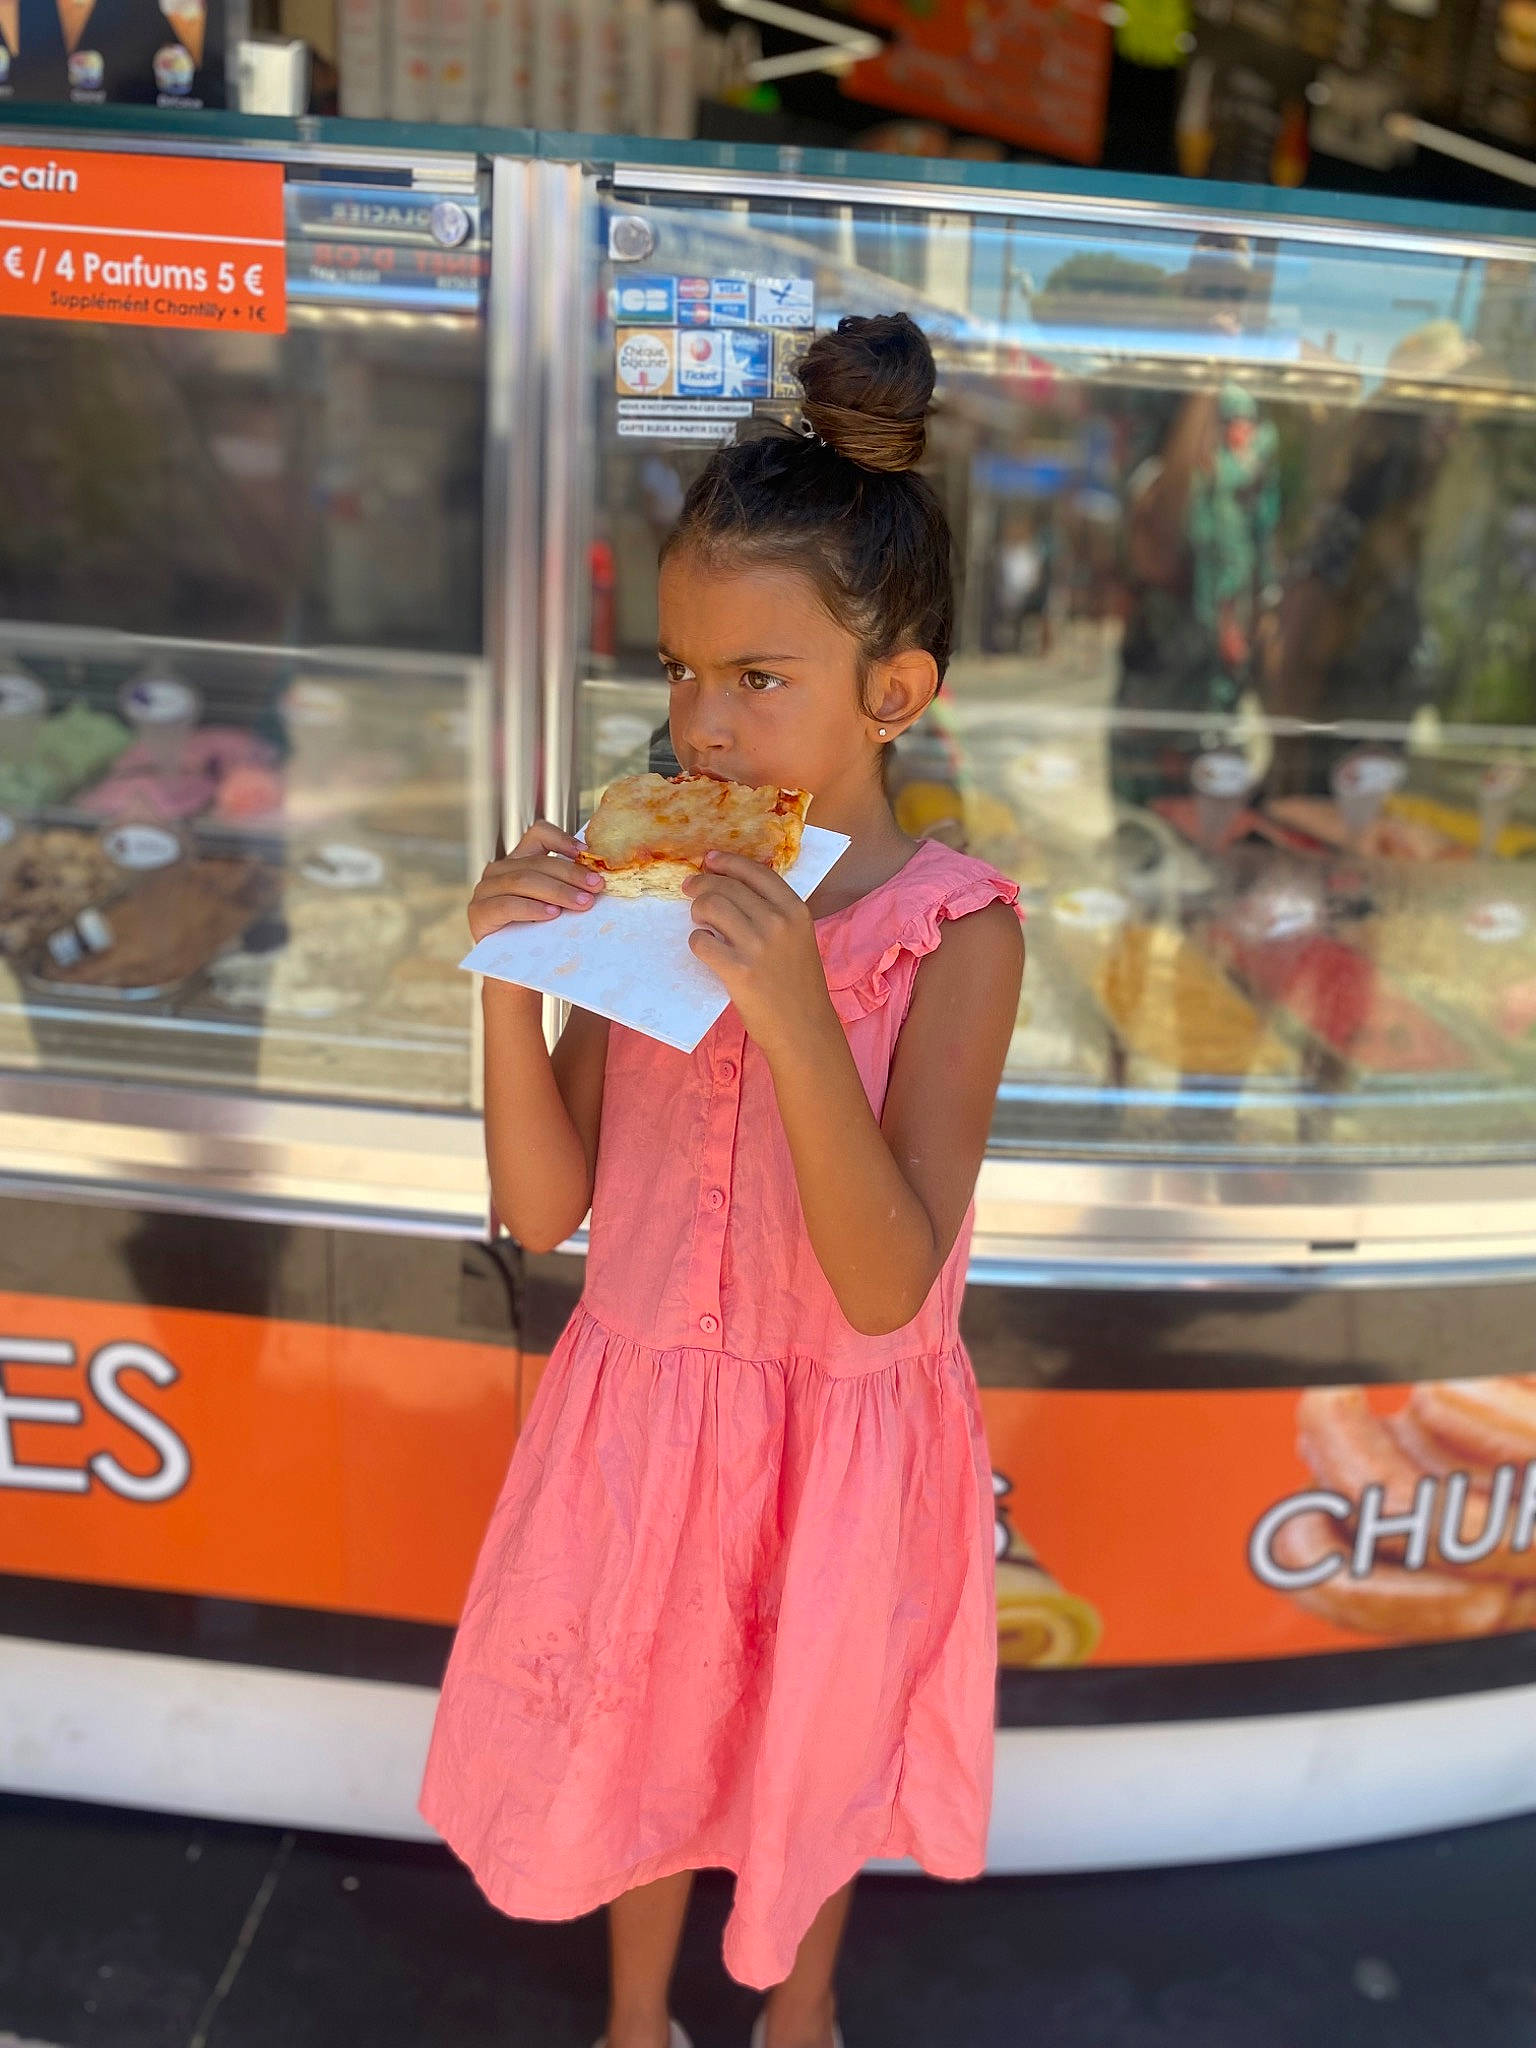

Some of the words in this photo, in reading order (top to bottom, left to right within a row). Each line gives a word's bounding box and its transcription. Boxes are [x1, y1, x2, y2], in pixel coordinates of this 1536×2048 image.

[0, 161, 79, 192] cain
[3, 246, 24, 279] €
[54, 249, 76, 283] 4
[82, 252, 208, 293] Parfums
[216, 261, 236, 294] 5
[243, 263, 265, 297] €
[153, 297, 227, 322] Chantilly
[757, 311, 812, 325] ancv
[0, 1336, 191, 1502] ES
